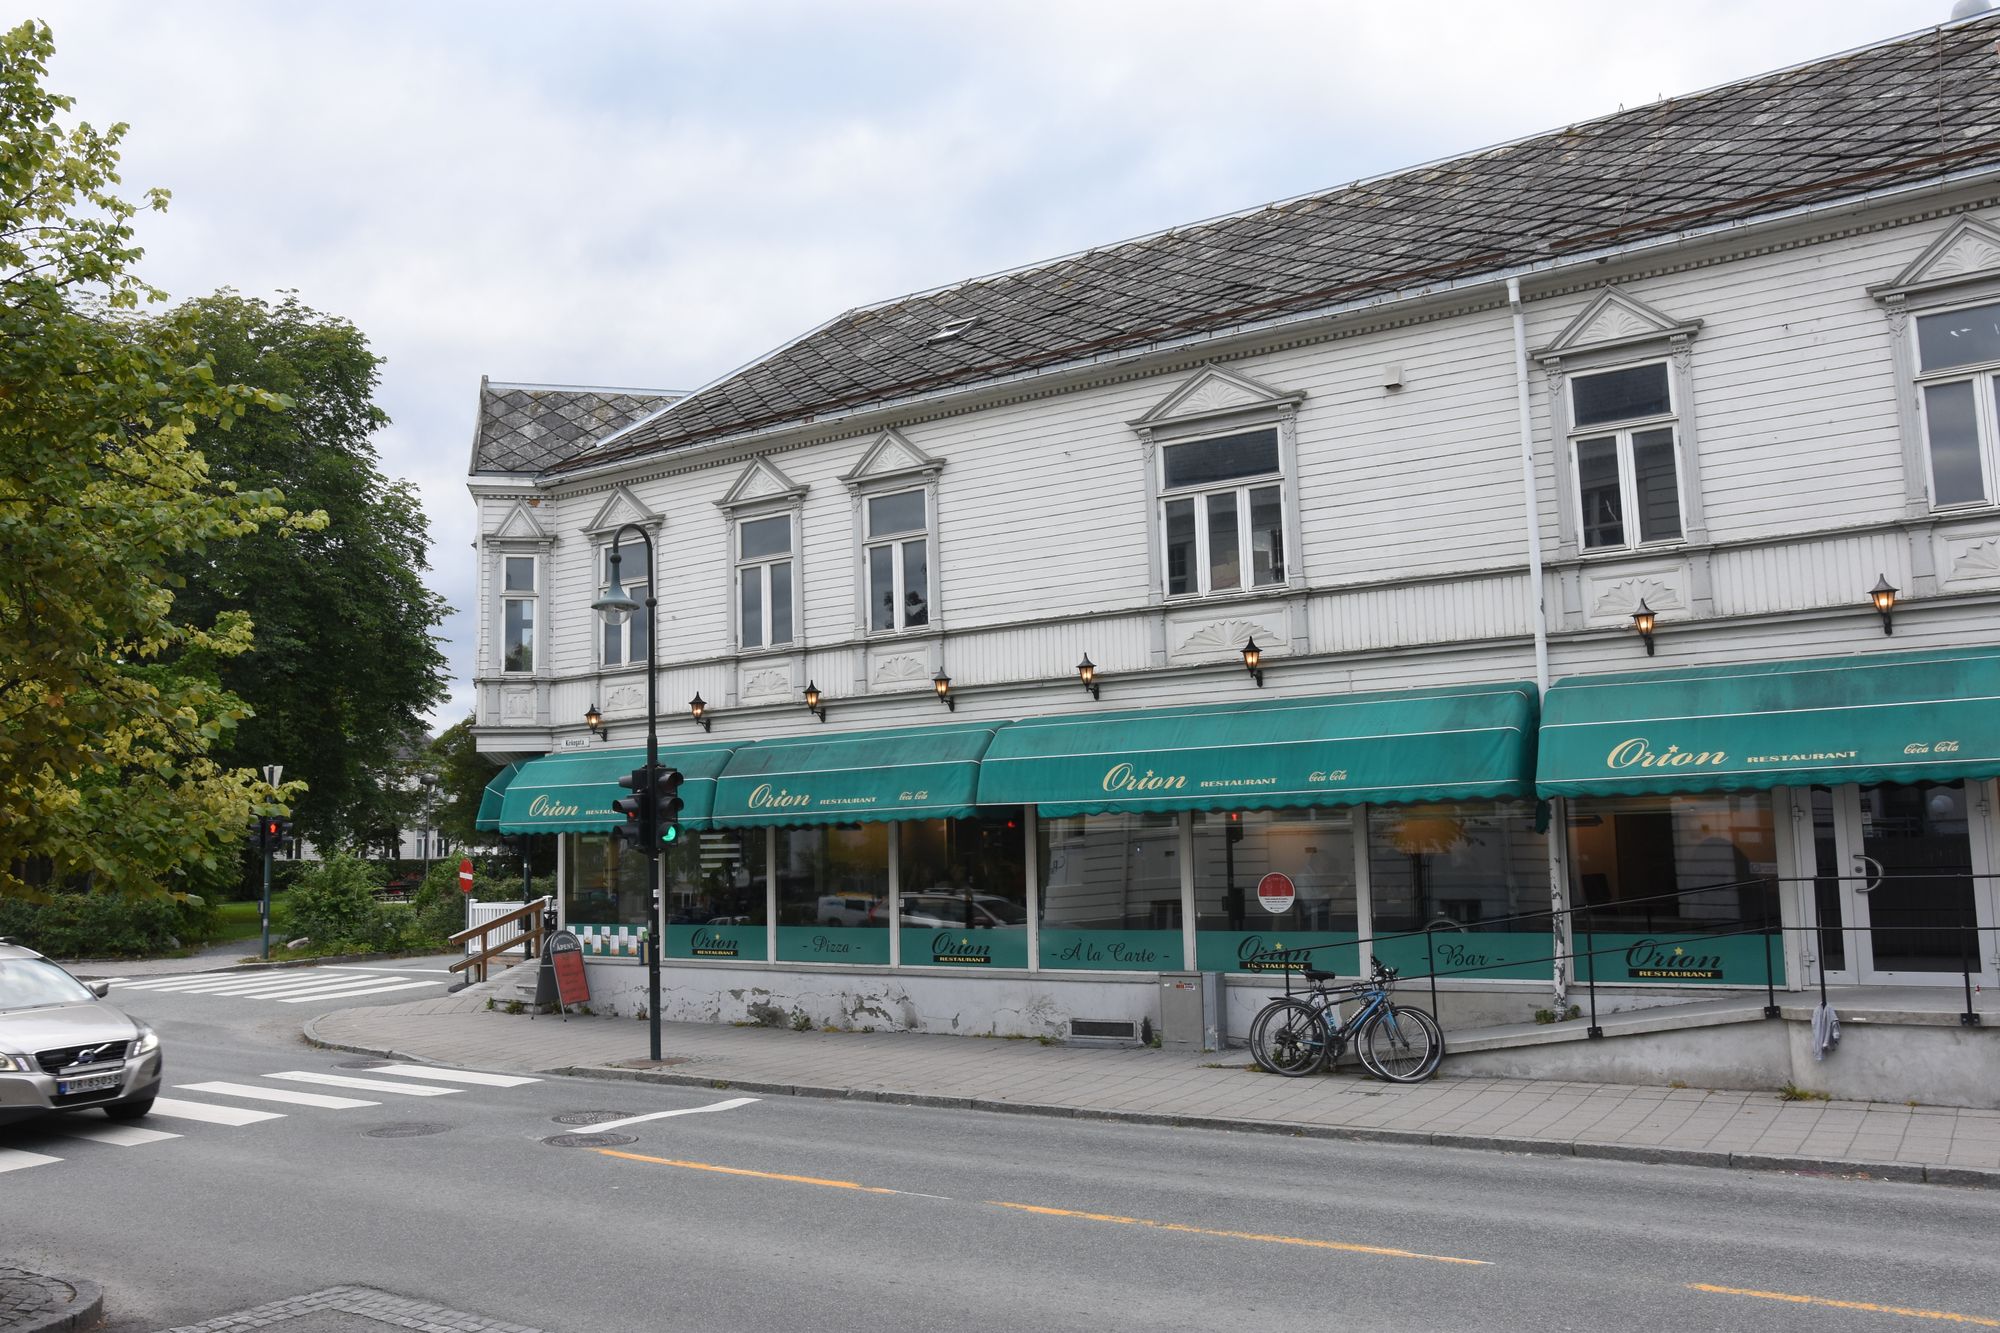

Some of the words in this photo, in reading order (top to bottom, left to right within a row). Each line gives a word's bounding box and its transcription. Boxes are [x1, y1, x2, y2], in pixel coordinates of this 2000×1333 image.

[1606, 738, 1729, 769] Orion
[1746, 751, 1858, 763] RESTAURANT
[1904, 743, 1929, 754] Coca
[1934, 741, 1960, 753] Cola
[1102, 762, 1188, 792] Orion
[1200, 777, 1278, 787] RESTAURANT
[1308, 771, 1326, 782] Coca
[1329, 769, 1347, 781] Cola
[528, 795, 580, 817] Orion
[748, 783, 811, 809] Orion
[819, 797, 877, 805] RESTAURANT
[690, 928, 738, 949] Orion
[812, 935, 850, 953] Pizza
[931, 932, 991, 955] Orion
[1087, 943, 1102, 961] la
[1107, 943, 1156, 962] Carte
[1437, 945, 1488, 966] Bar
[1625, 939, 1723, 968] Orion
[1638, 970, 1713, 978] RESTAURANT
